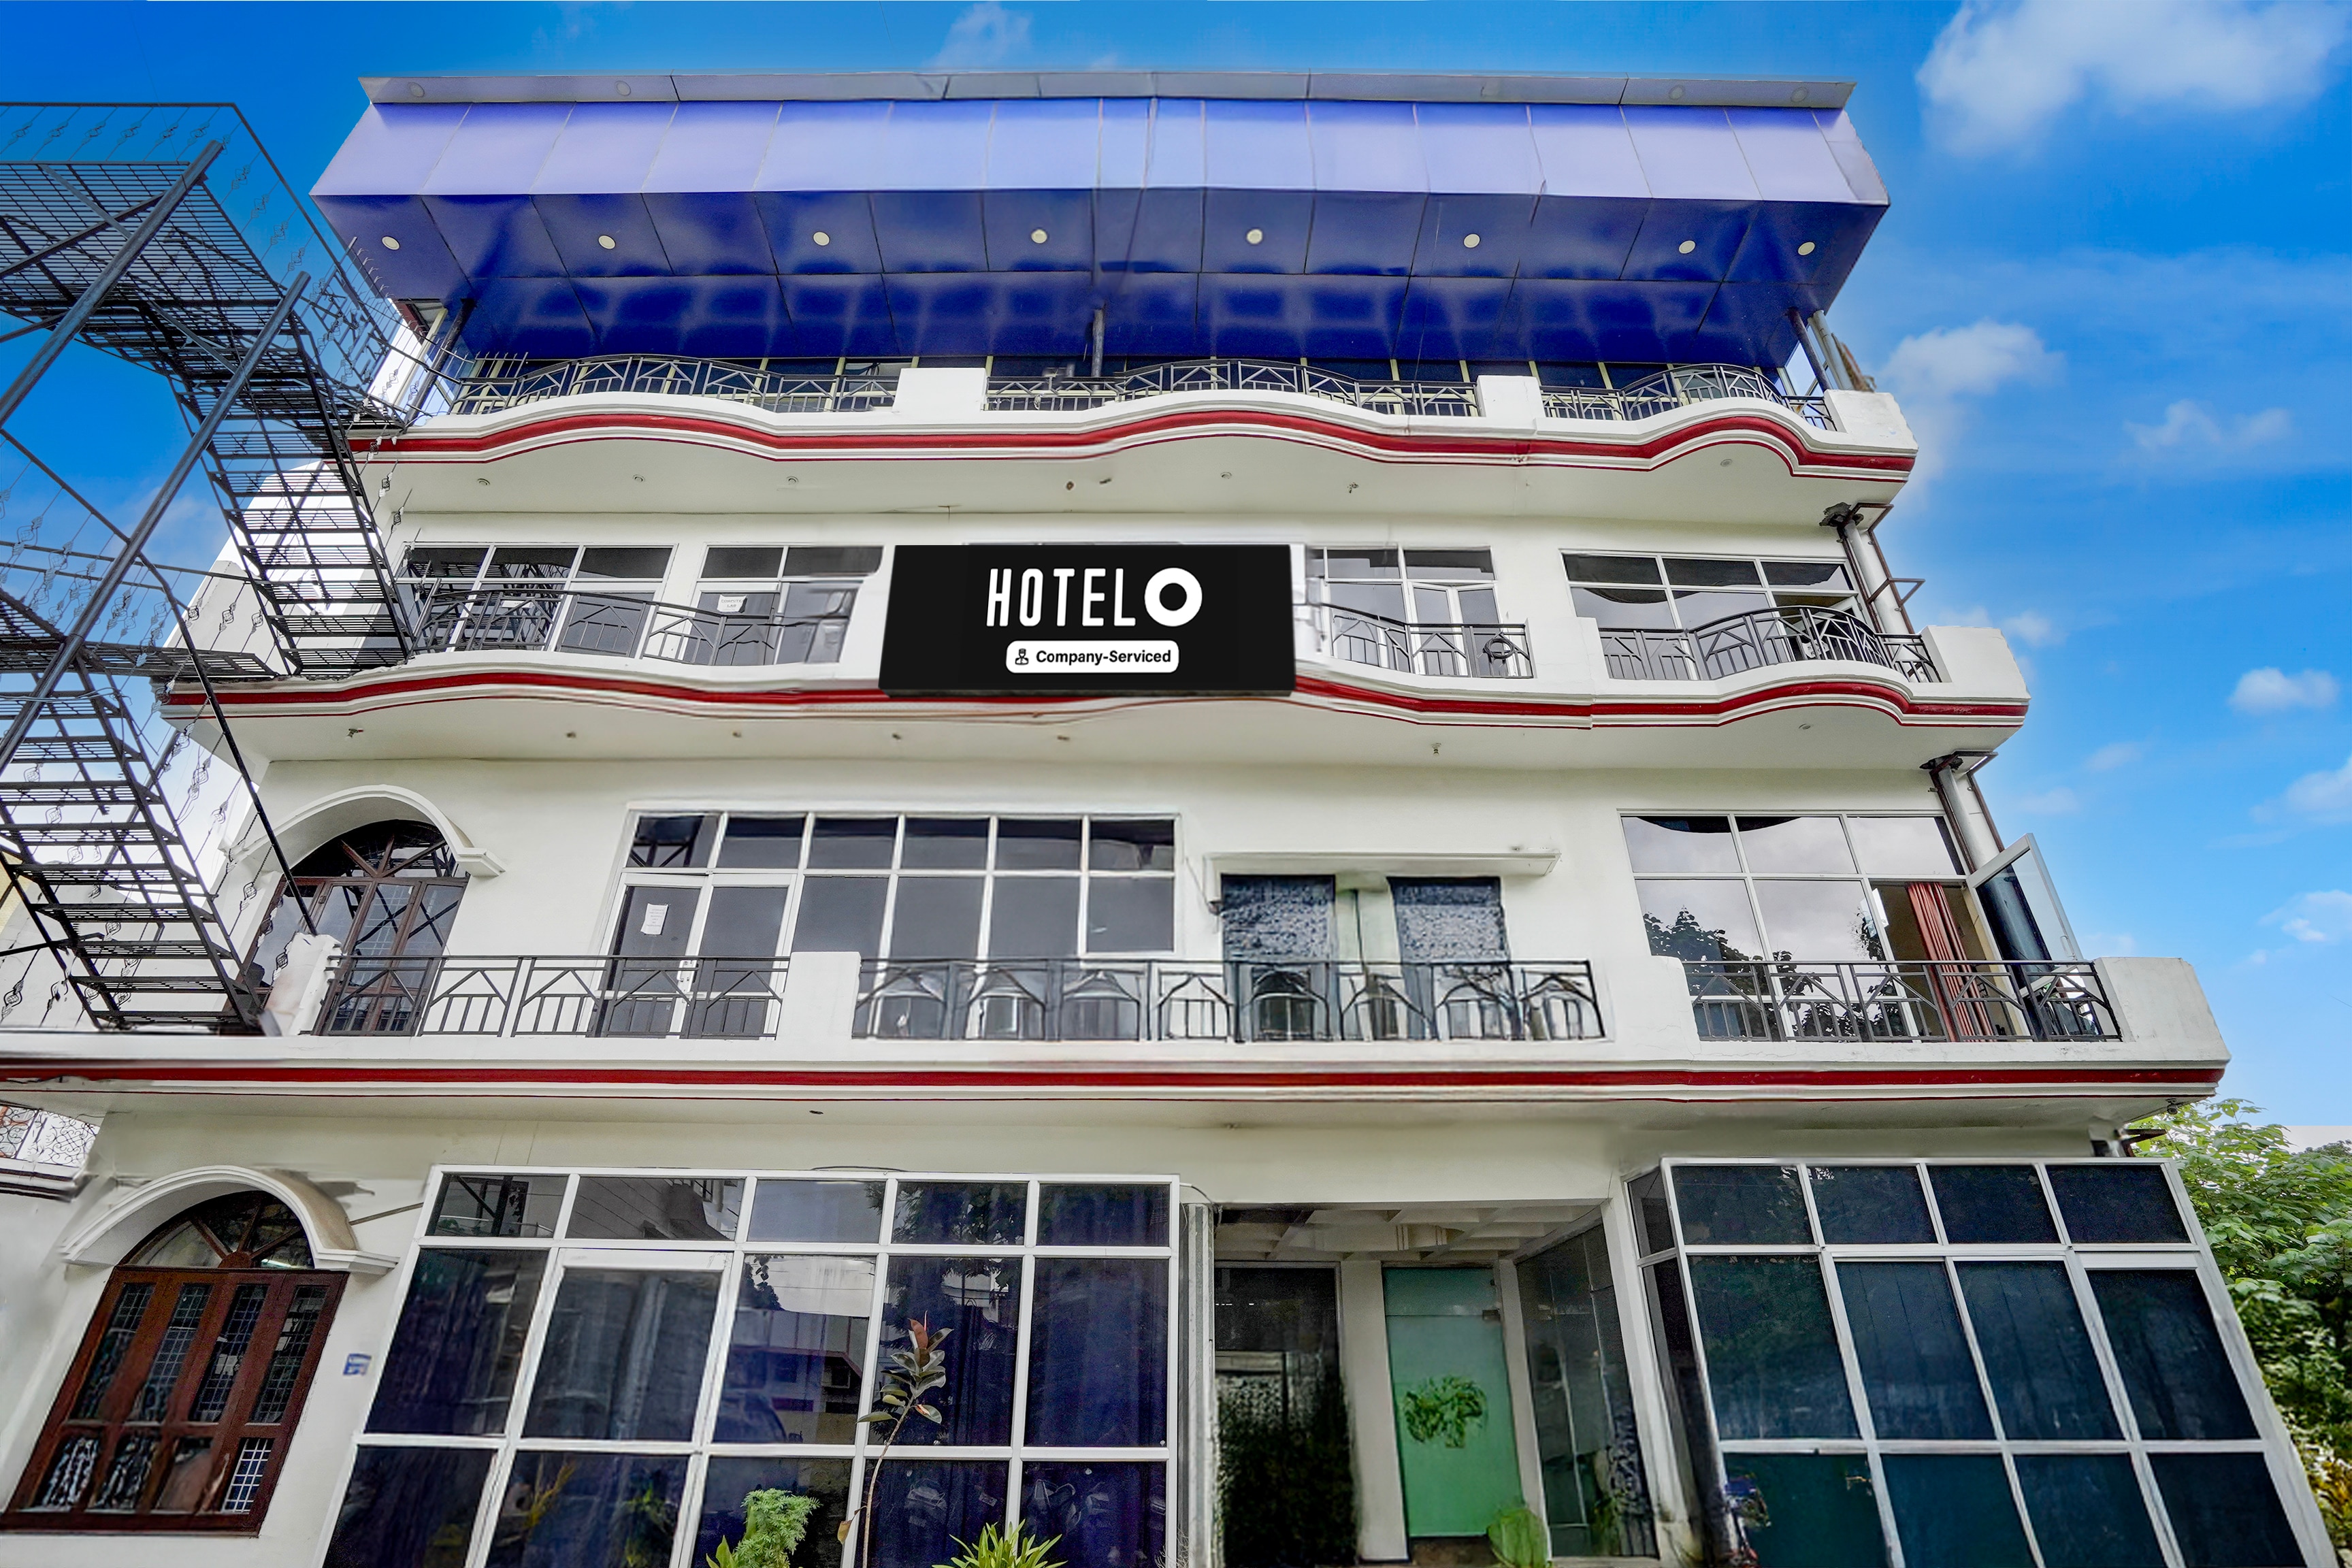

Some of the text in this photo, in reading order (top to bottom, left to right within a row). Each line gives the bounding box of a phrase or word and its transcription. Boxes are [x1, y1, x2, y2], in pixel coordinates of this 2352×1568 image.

[987, 568, 1203, 627] HOTEL O
[1036, 649, 1171, 666] Company-Serviced
